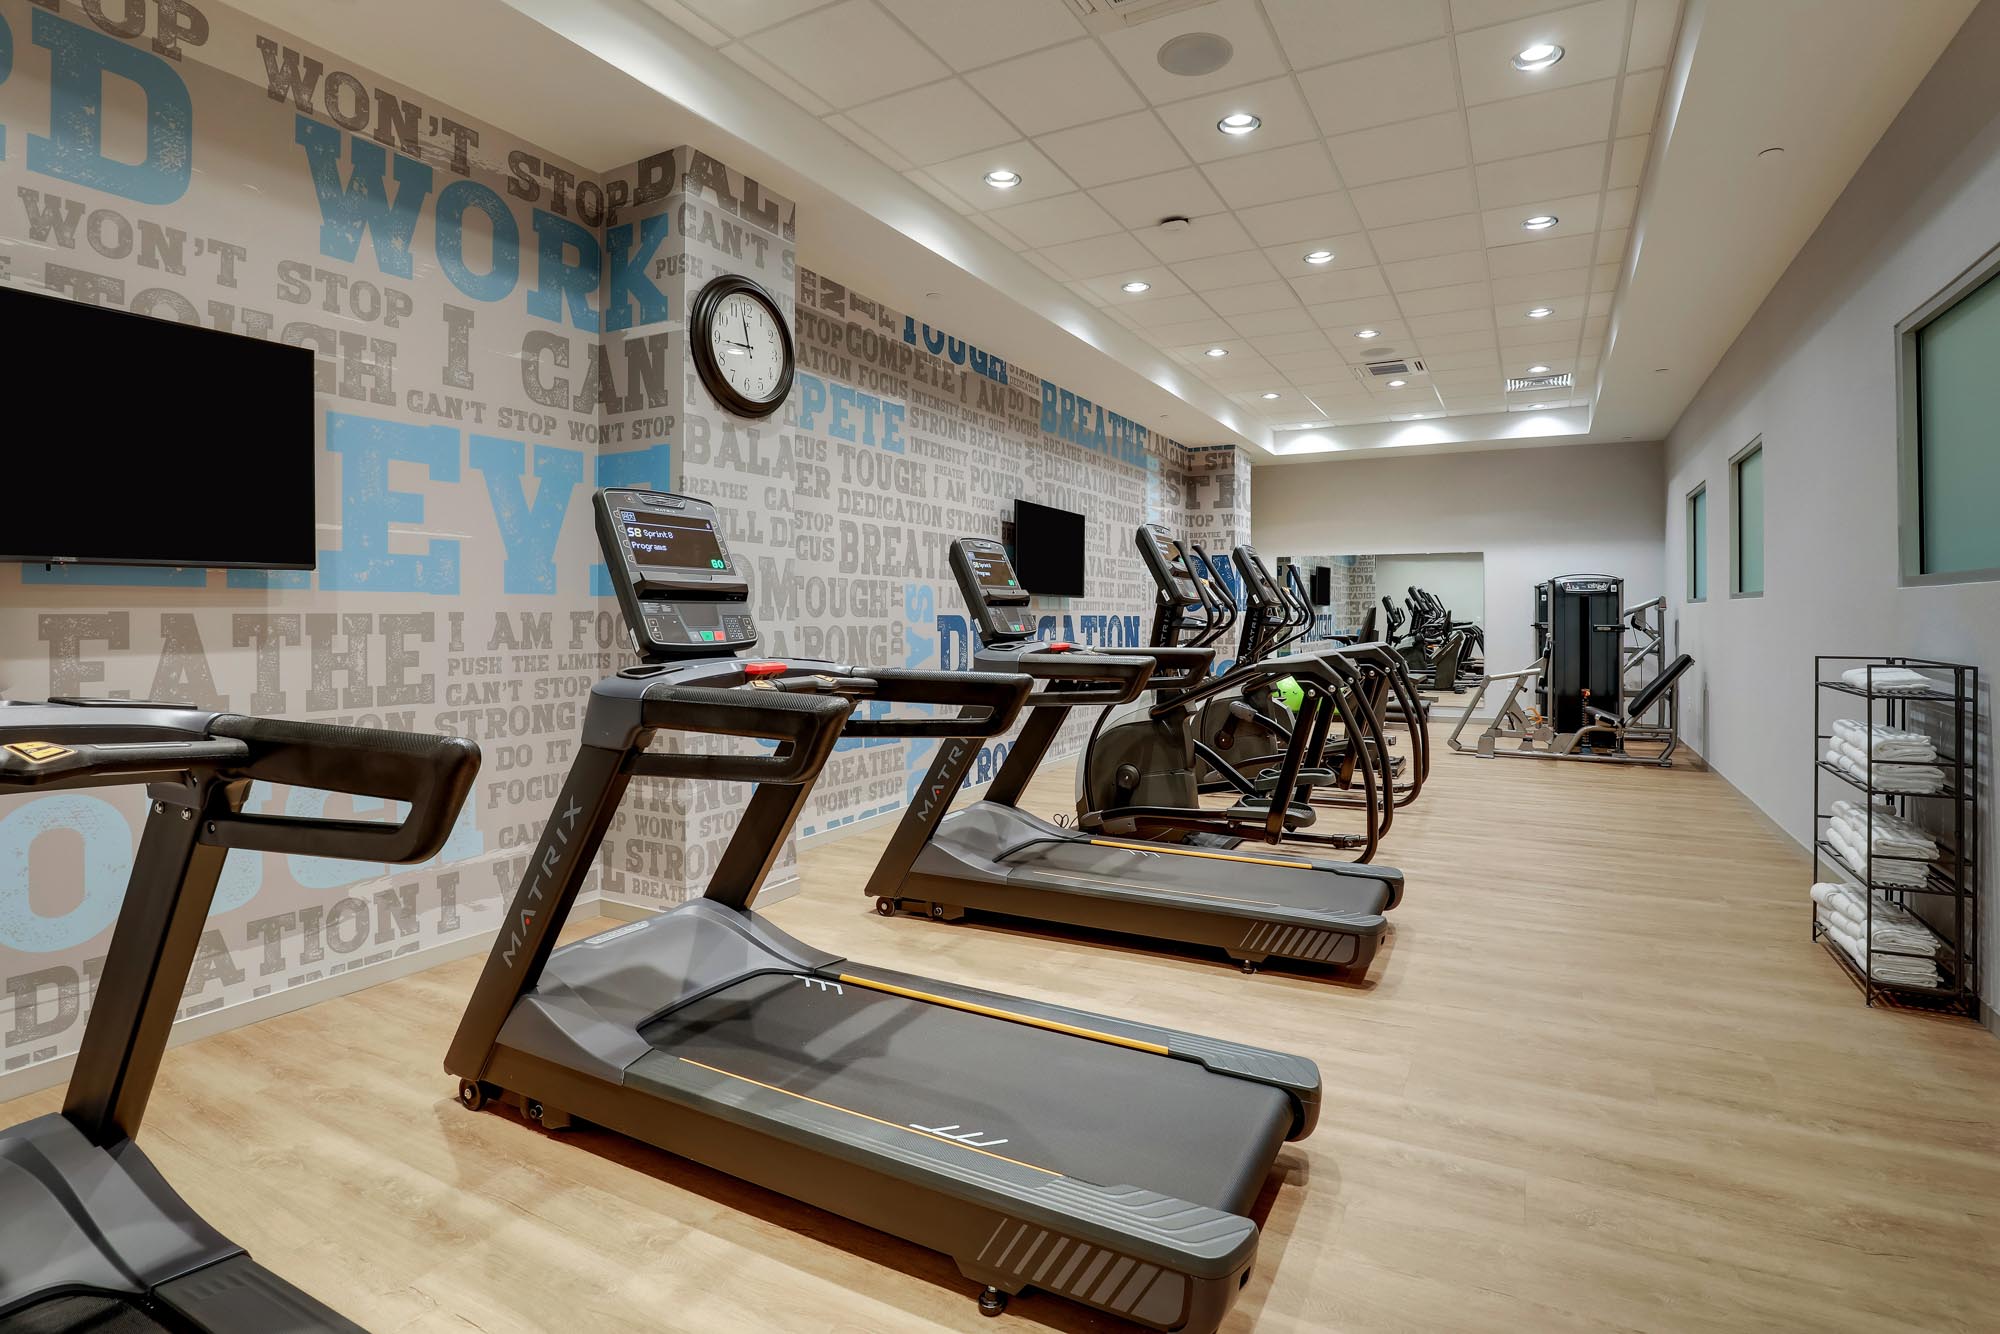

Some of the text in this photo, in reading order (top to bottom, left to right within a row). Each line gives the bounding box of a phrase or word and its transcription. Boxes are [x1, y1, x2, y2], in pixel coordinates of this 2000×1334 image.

[257, 34, 479, 178] WON'T
[507, 149, 629, 229] STOP
[295, 113, 669, 334] WORK
[677, 201, 769, 270] CAN'T
[17, 186, 414, 328] WON'T STOP
[656, 251, 704, 279] PUSH
[719, 311, 729, 328] 10
[730, 302, 738, 318] 11
[743, 302, 753, 319] 12
[714, 329, 721, 344] 9
[443, 303, 475, 390] I
[521, 330, 669, 416] CAN
[718, 352, 726, 367] 8
[730, 368, 736, 383] 7
[846, 321, 956, 394] COMPETE
[976, 380, 1006, 418] AM
[743, 377, 750, 392] 6
[857, 364, 909, 400] FOCUS
[911, 388, 960, 417] INTENSITY
[406, 389, 676, 446] CAN'T STOP WON'T STOP
[1008, 387, 1041, 419] DO IT
[909, 406, 1023, 460] STRONG BREATHE
[1008, 413, 1039, 440] FOCUS
[1041, 378, 1148, 470] BREATHE
[910, 435, 969, 468] INTENSITY
[1043, 436, 1083, 464] BREATHE
[837, 442, 928, 499] TOUGH
[969, 464, 1024, 501] POWER
[1043, 453, 1118, 499] DEDICATION
[679, 475, 718, 501] BREATHE
[945, 480, 968, 505] AM
[837, 487, 943, 529] DEDICATION
[946, 508, 999, 537] STRONG
[1104, 501, 1140, 526] STRONG
[1184, 512, 1214, 528] STOP
[631, 541, 668, 552] Programs
[448, 611, 465, 652] I
[487, 611, 553, 650] AM
[1246, 611, 1259, 651] MATRIX
[447, 656, 503, 676] PUSH
[511, 653, 550, 673] THE
[557, 652, 611, 672] LIMITS
[445, 675, 592, 707] CAN'T STOP
[434, 701, 576, 740] STRONG
[495, 739, 572, 772] DO IT
[814, 776, 905, 817] WON'T STOP
[634, 814, 690, 842] WON'T
[502, 794, 582, 968] MATRIX
[436, 871, 461, 935] I
